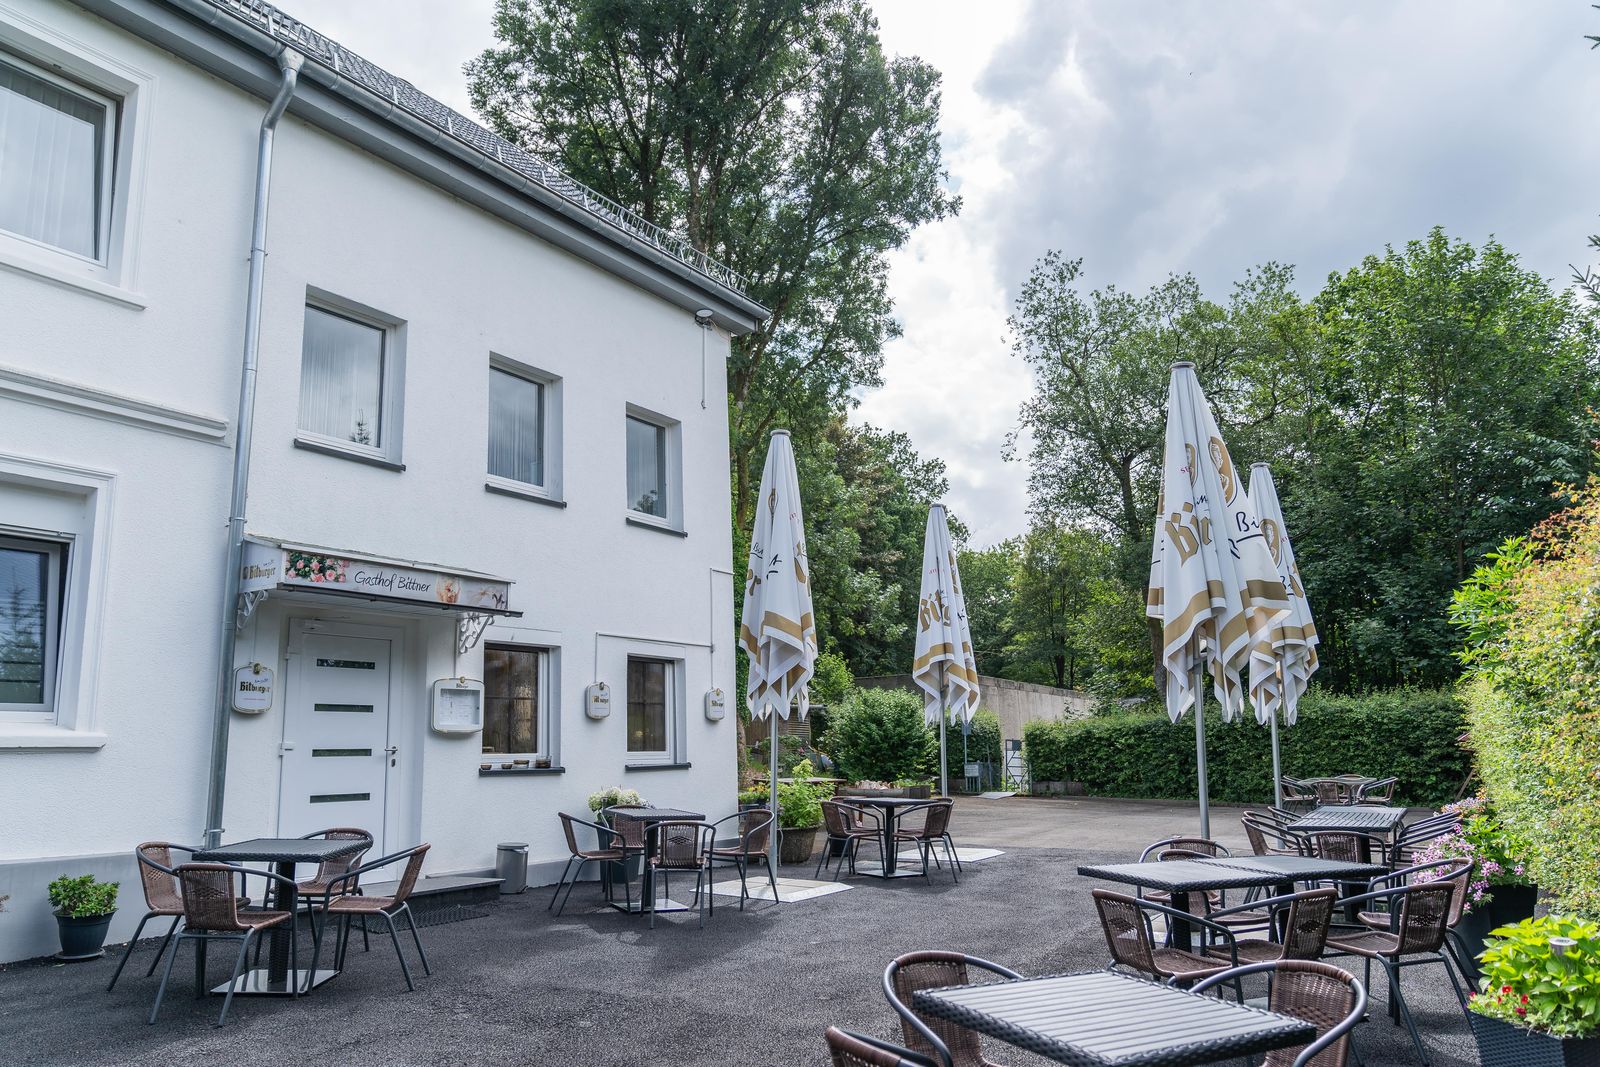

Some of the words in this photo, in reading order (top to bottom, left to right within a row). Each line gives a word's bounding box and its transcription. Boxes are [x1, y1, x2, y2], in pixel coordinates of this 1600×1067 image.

[354, 571, 397, 592] Gasthof
[397, 577, 431, 592] Bittner
[240, 681, 270, 693] Bitburgr
